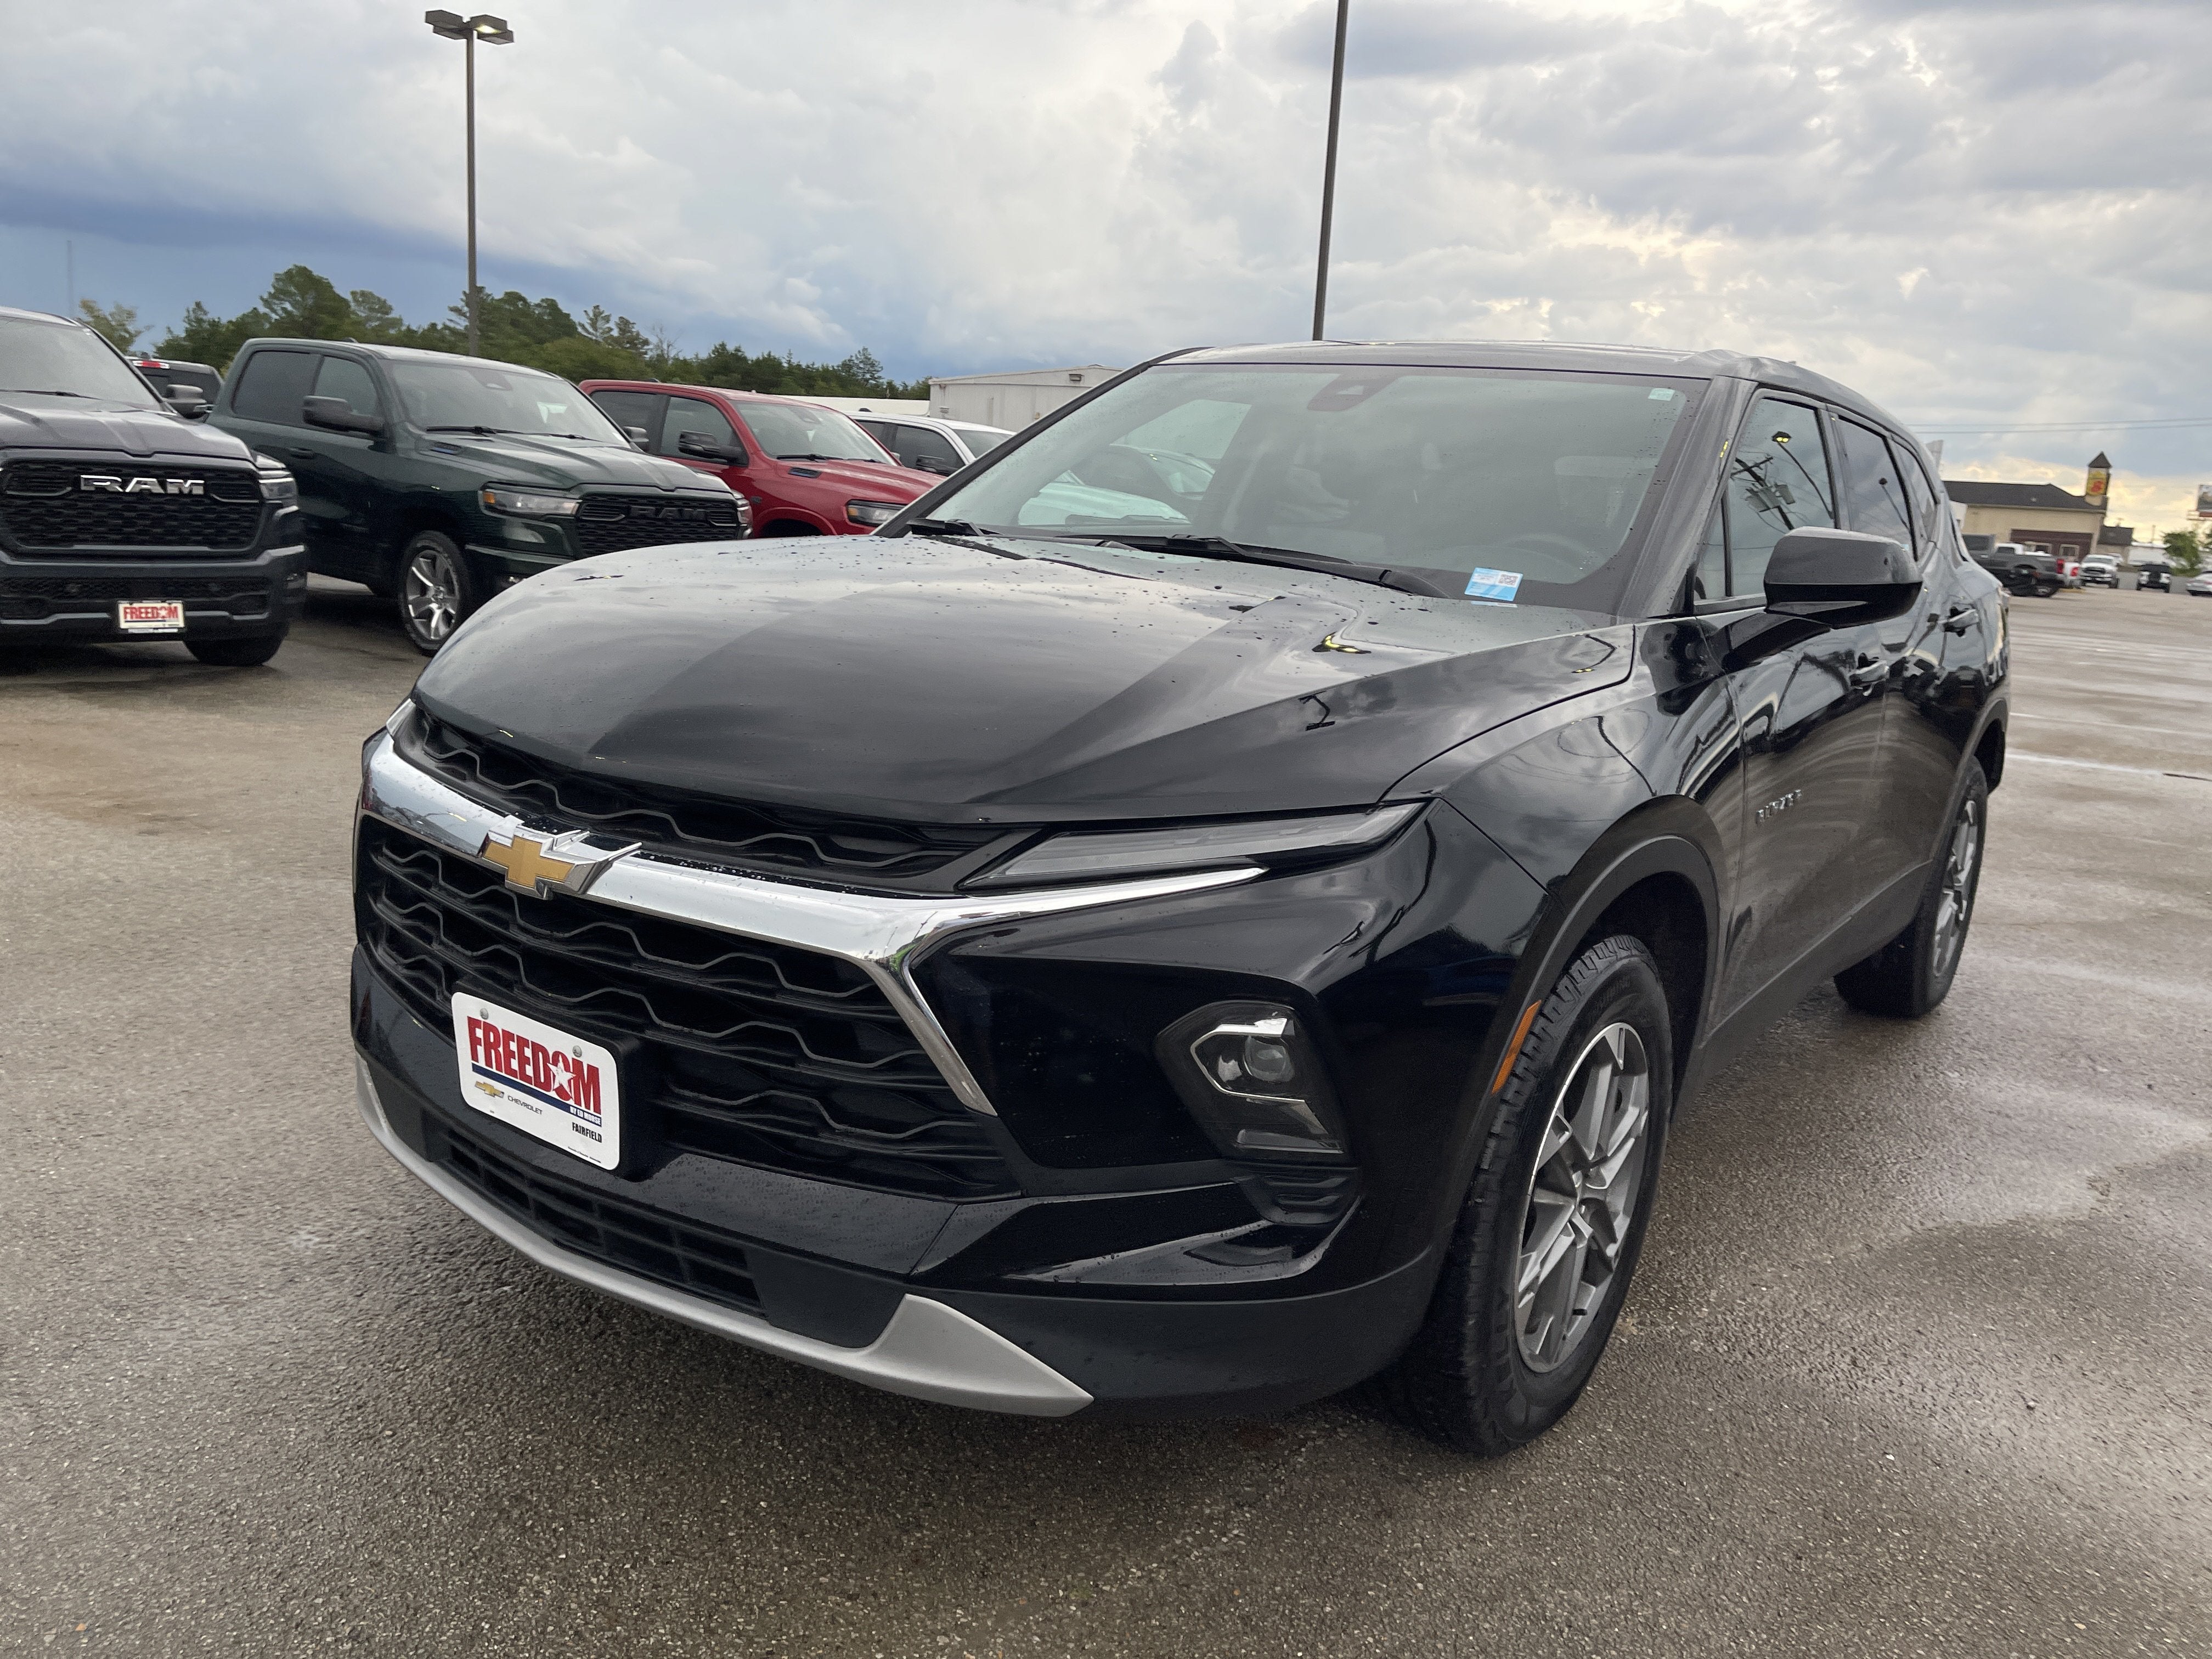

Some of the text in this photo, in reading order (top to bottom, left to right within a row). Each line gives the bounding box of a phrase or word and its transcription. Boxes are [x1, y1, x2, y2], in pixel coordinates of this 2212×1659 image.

[80, 475, 205, 494] RAM
[630, 505, 706, 520] RAM
[123, 606, 178, 619] FREEDOM
[467, 1016, 601, 1115] FREEDOM
[507, 1095, 543, 1115] CHEVROLET
[572, 1122, 602, 1143] FAIRFIELD
